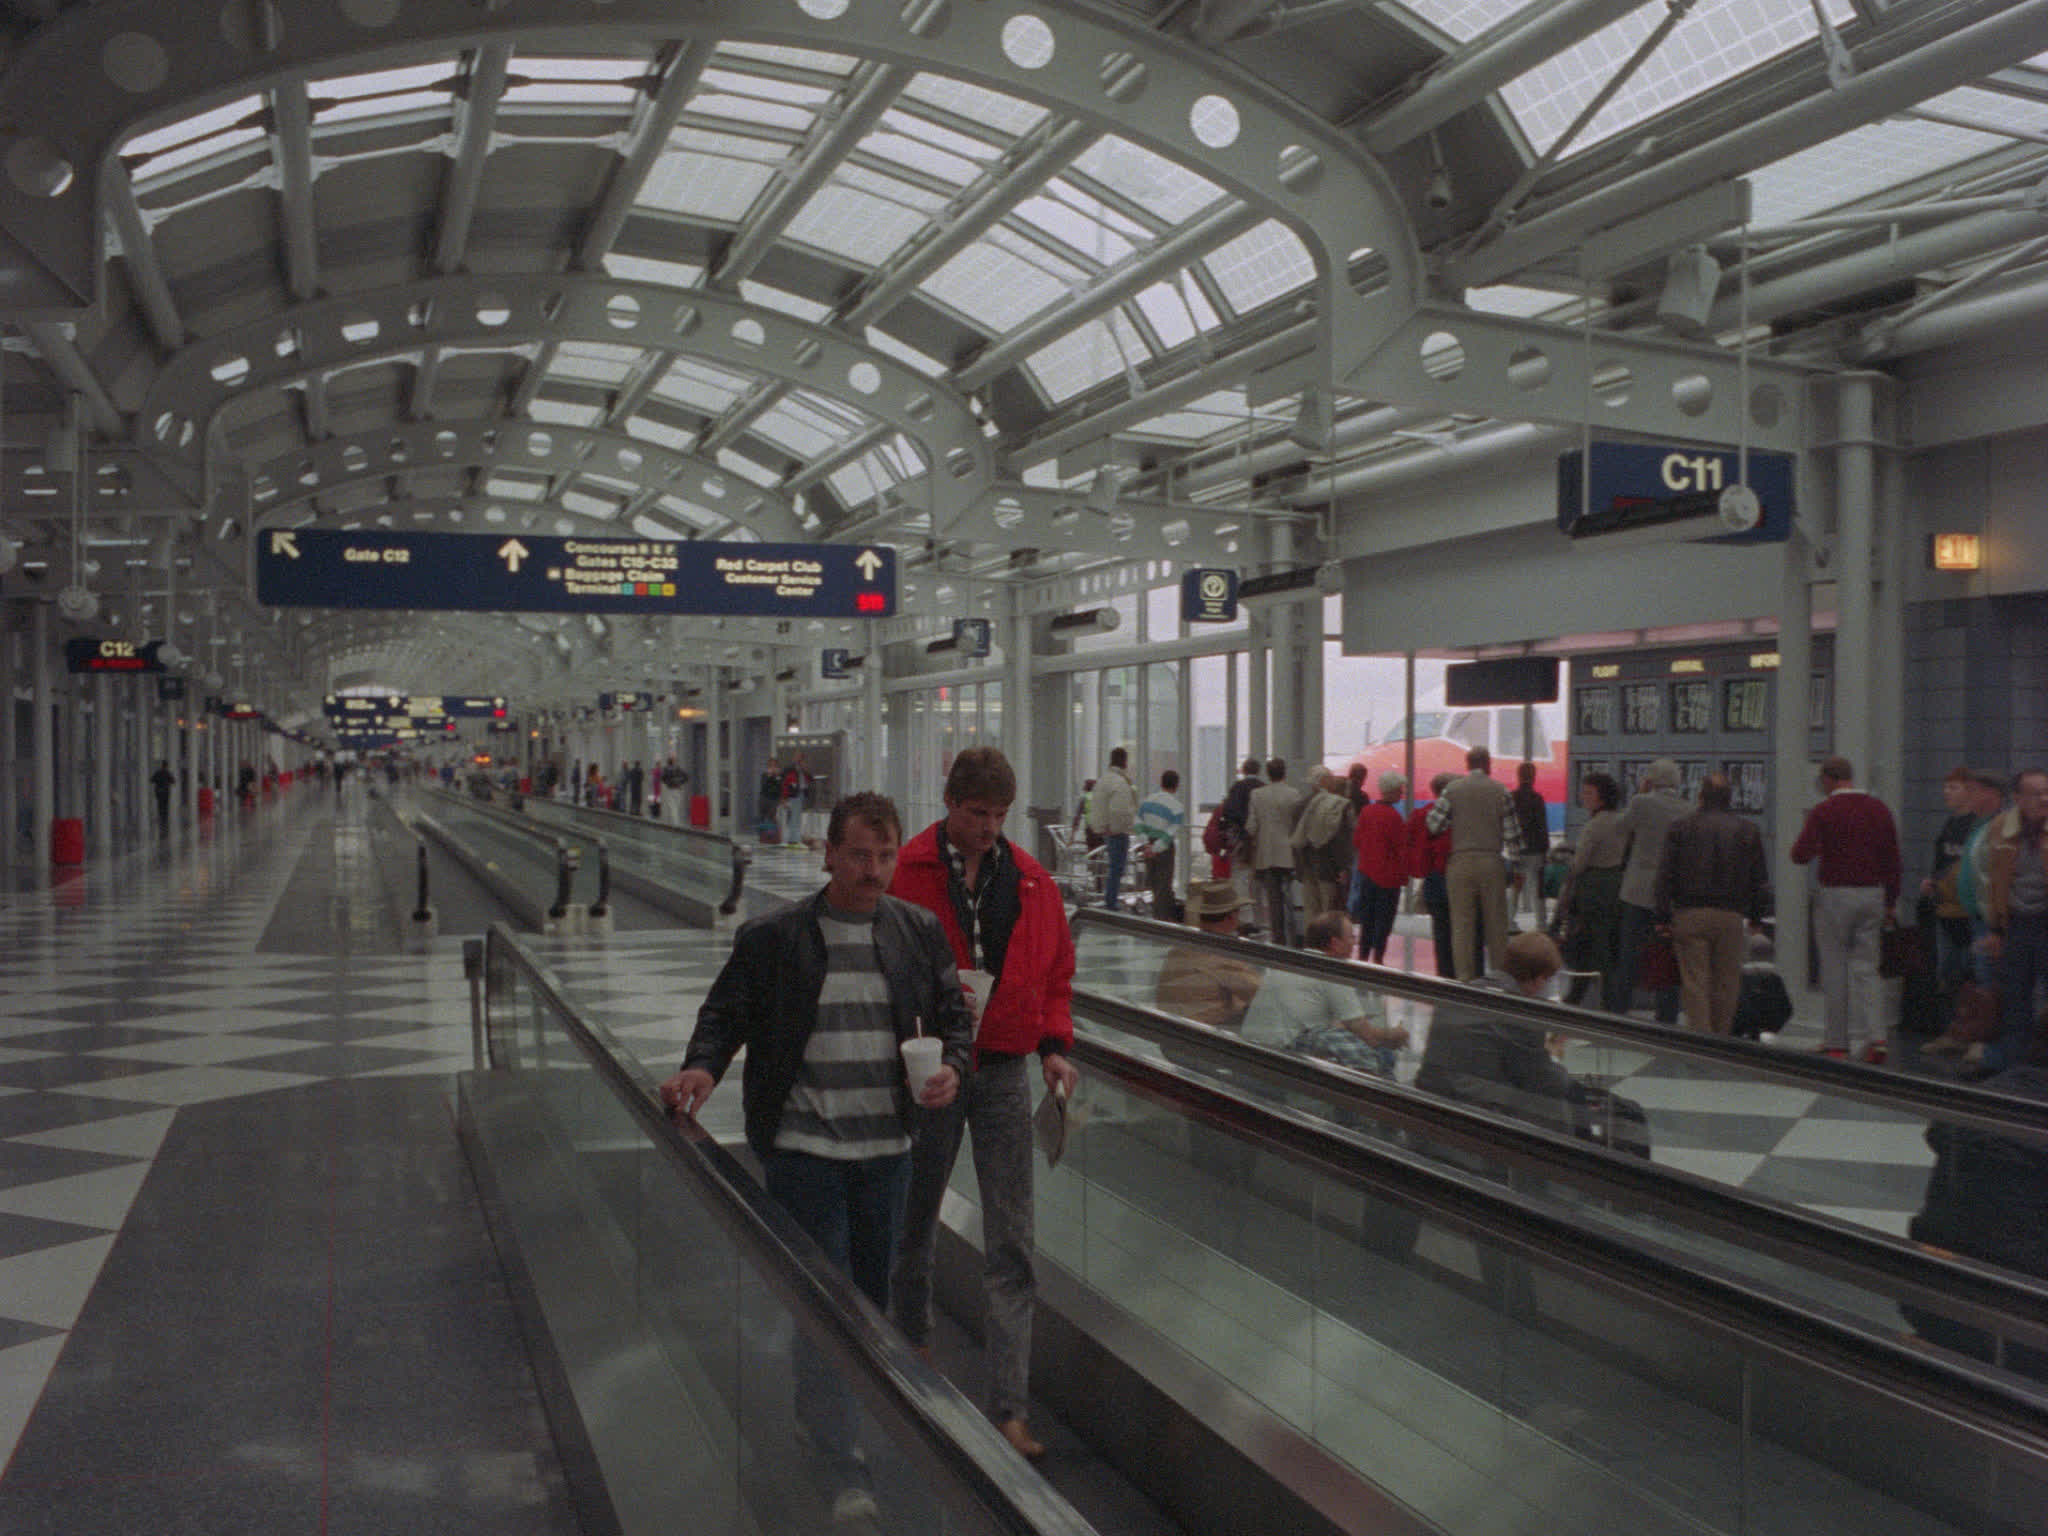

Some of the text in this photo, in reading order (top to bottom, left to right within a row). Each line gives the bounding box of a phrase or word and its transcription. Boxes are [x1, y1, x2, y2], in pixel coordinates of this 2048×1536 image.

[1662, 453, 1721, 491] C11
[565, 541, 636, 554] Concourse
[344, 547, 409, 562] Gate C12
[576, 555, 617, 568] Gates
[716, 558, 822, 573] Red Carpet Club
[564, 568, 665, 582] Baggage Claim
[725, 572, 822, 585] Customer Service
[566, 582, 621, 594] Terminal
[776, 585, 814, 596] Center
[100, 641, 134, 657] C12
